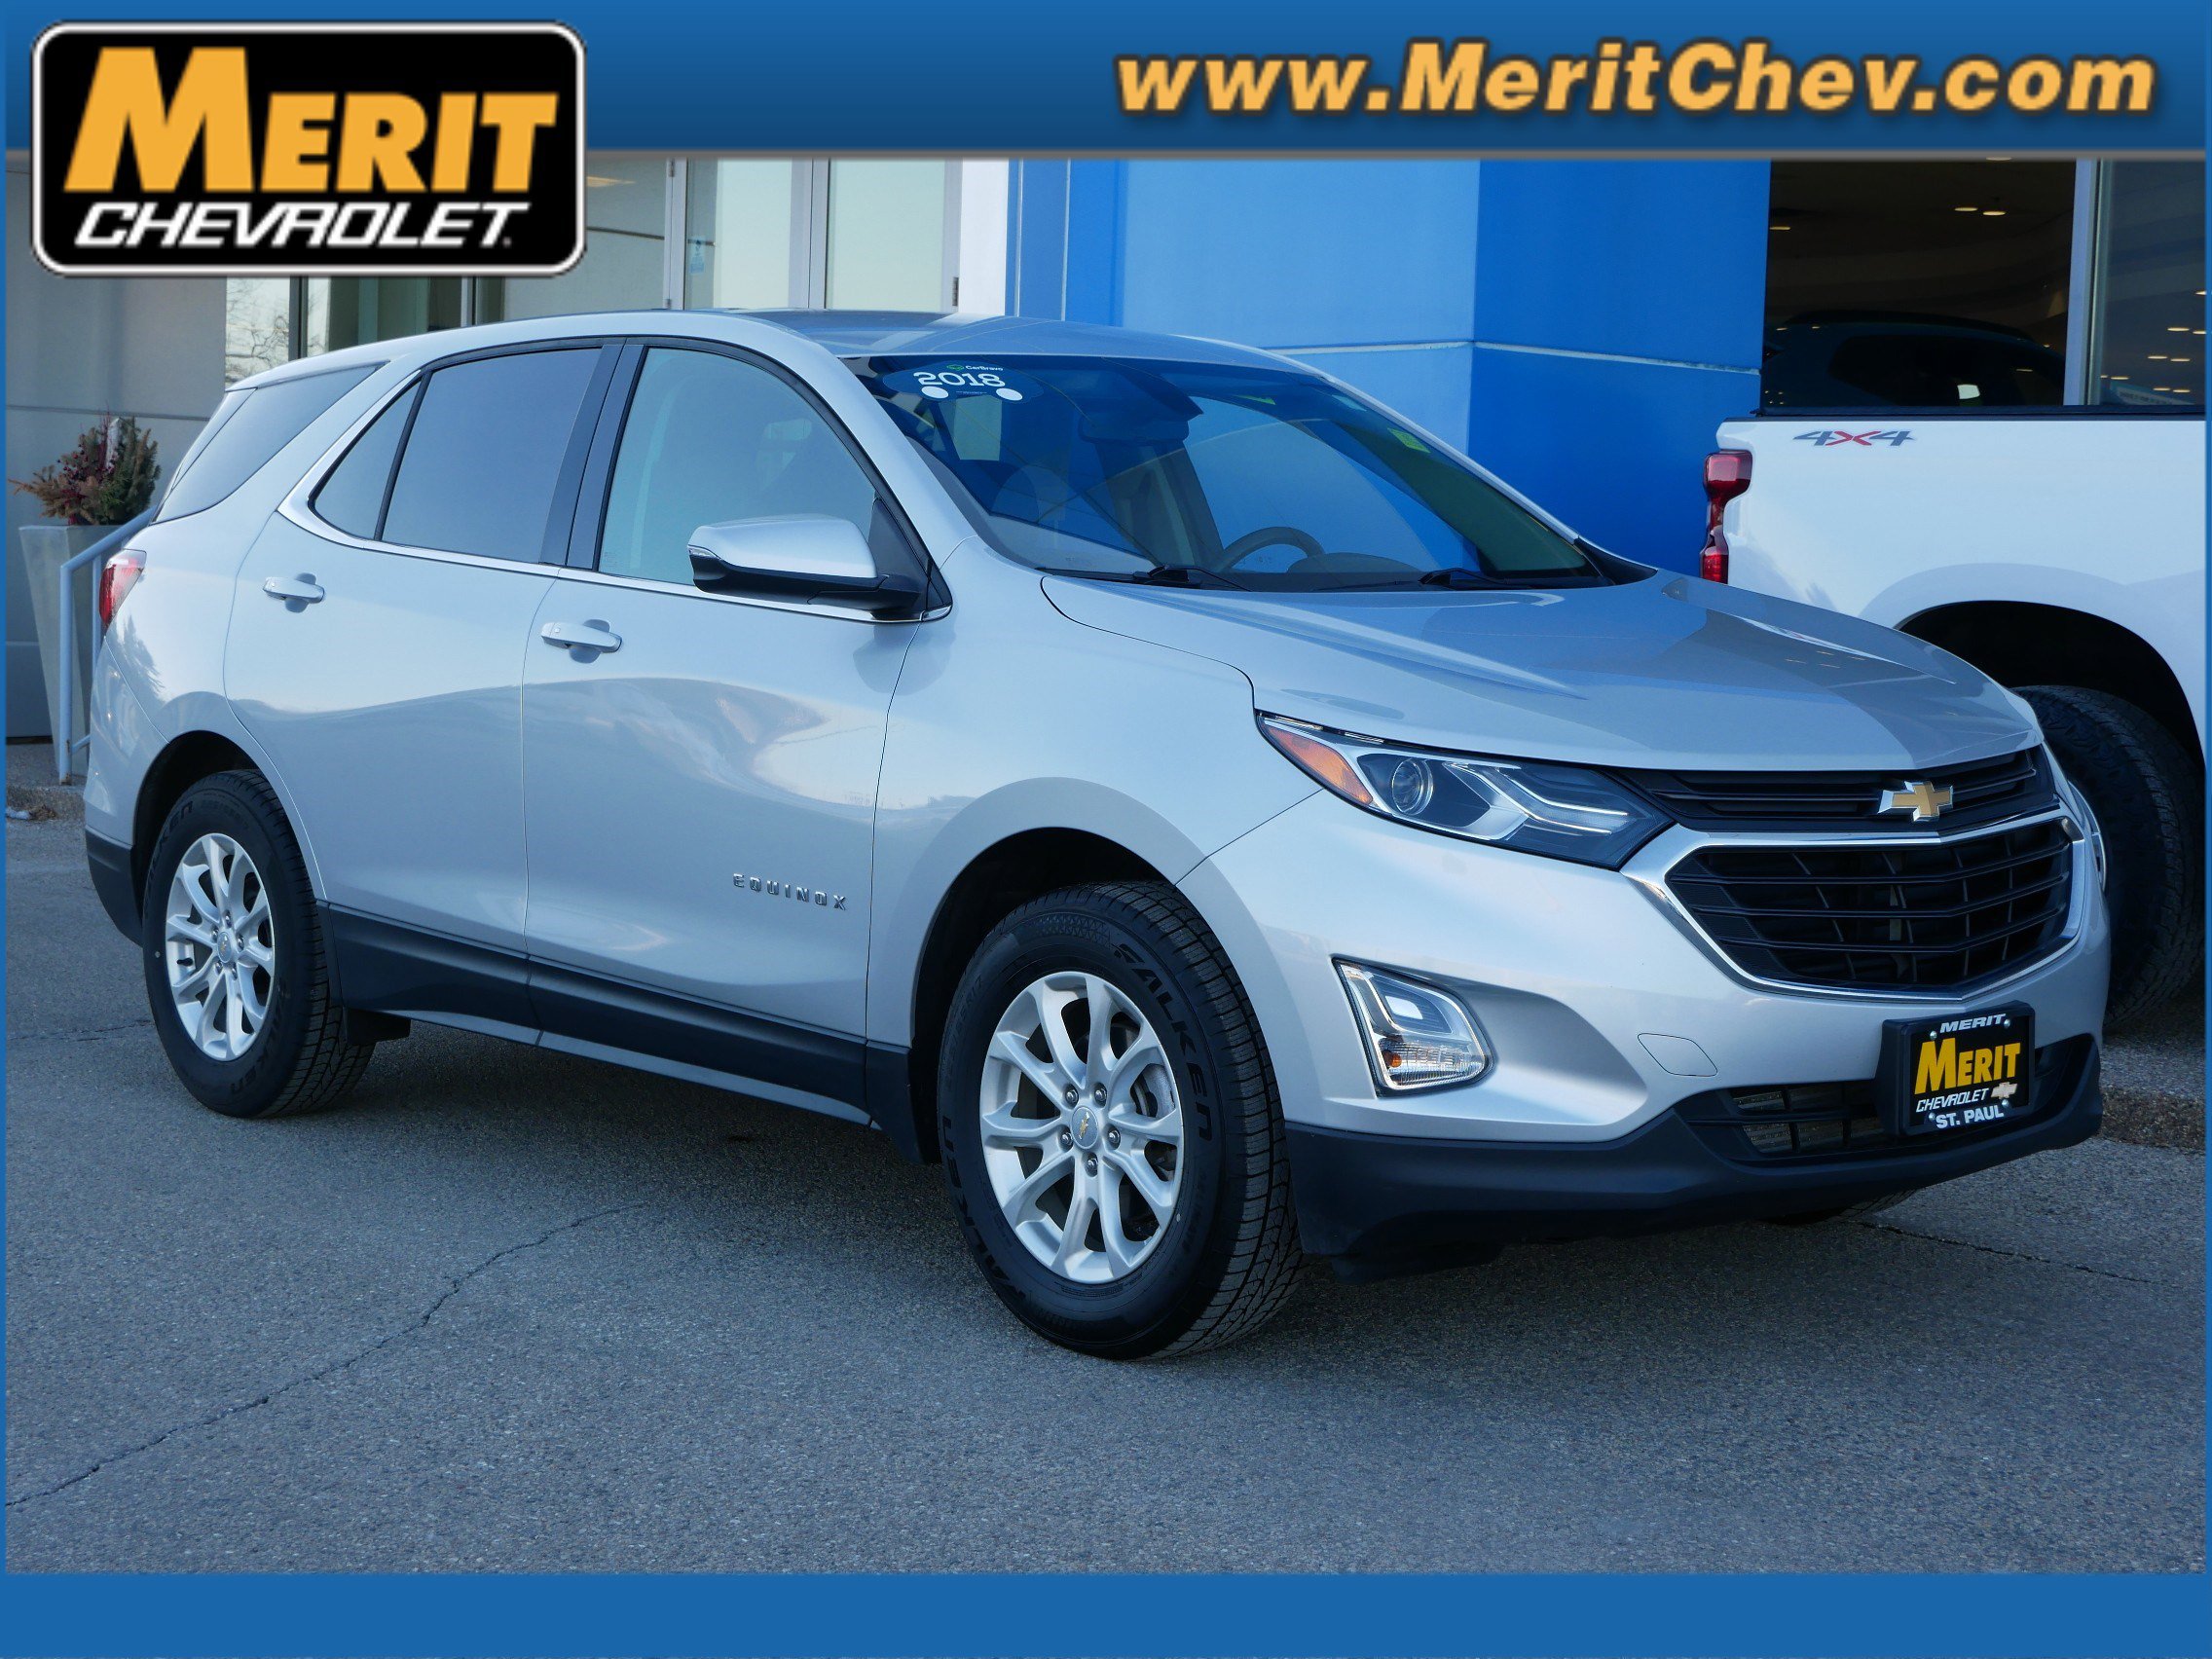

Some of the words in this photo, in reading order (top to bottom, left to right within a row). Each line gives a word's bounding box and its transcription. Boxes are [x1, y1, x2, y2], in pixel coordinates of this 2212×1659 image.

[913, 371, 1006, 387] 2018
[732, 872, 847, 911] EQUINOX
[1939, 1013, 2007, 1034] MERIT
[1112, 942, 1213, 1141] FALKEN
[1914, 1037, 2021, 1095] MERIT
[1915, 1088, 1990, 1113] CHEVROLET
[1936, 1113, 1961, 1129] ST.
[1964, 1104, 2005, 1124] PAUL
